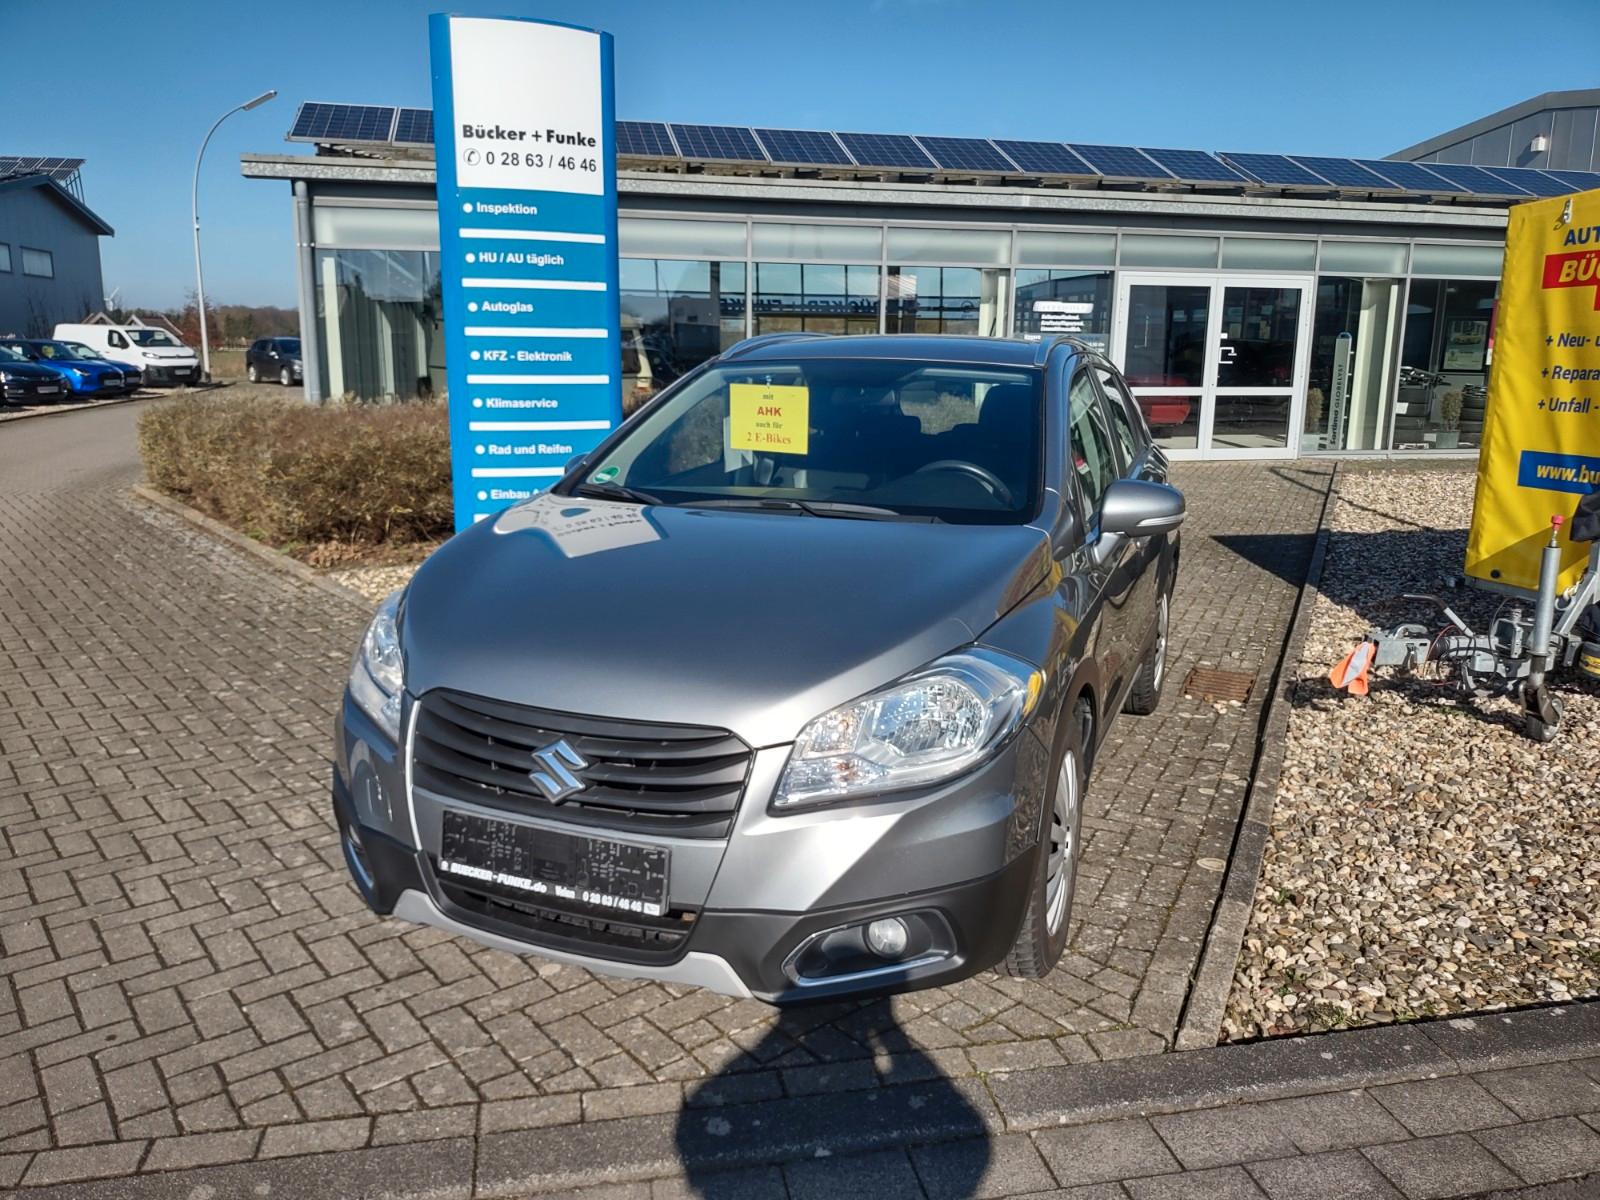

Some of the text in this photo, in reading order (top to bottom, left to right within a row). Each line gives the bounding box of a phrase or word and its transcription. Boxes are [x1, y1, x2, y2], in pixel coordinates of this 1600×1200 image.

[462, 124, 597, 147] Bücker + Funke
[486, 152, 597, 172] 0 28 63 / 46 46
[476, 202, 538, 215] Inspektion
[478, 252, 497, 263] HU
[506, 253, 524, 264] AU
[526, 253, 564, 267] täglich
[482, 301, 534, 314] Autoglas
[1557, 333, 1591, 348] Neu-
[483, 350, 508, 361] KFZ
[517, 351, 573, 362] Elektronik
[762, 392, 774, 400] mit
[486, 398, 558, 409] Klimaservice
[1548, 397, 1591, 413] Unfall
[757, 406, 782, 417] AHK
[772, 421, 783, 429] für
[746, 432, 792, 445] 2 E-Bikes
[488, 444, 573, 455] Rad und Reifen
[490, 489, 530, 500] Einbau
[582, 891, 590, 902] 0
